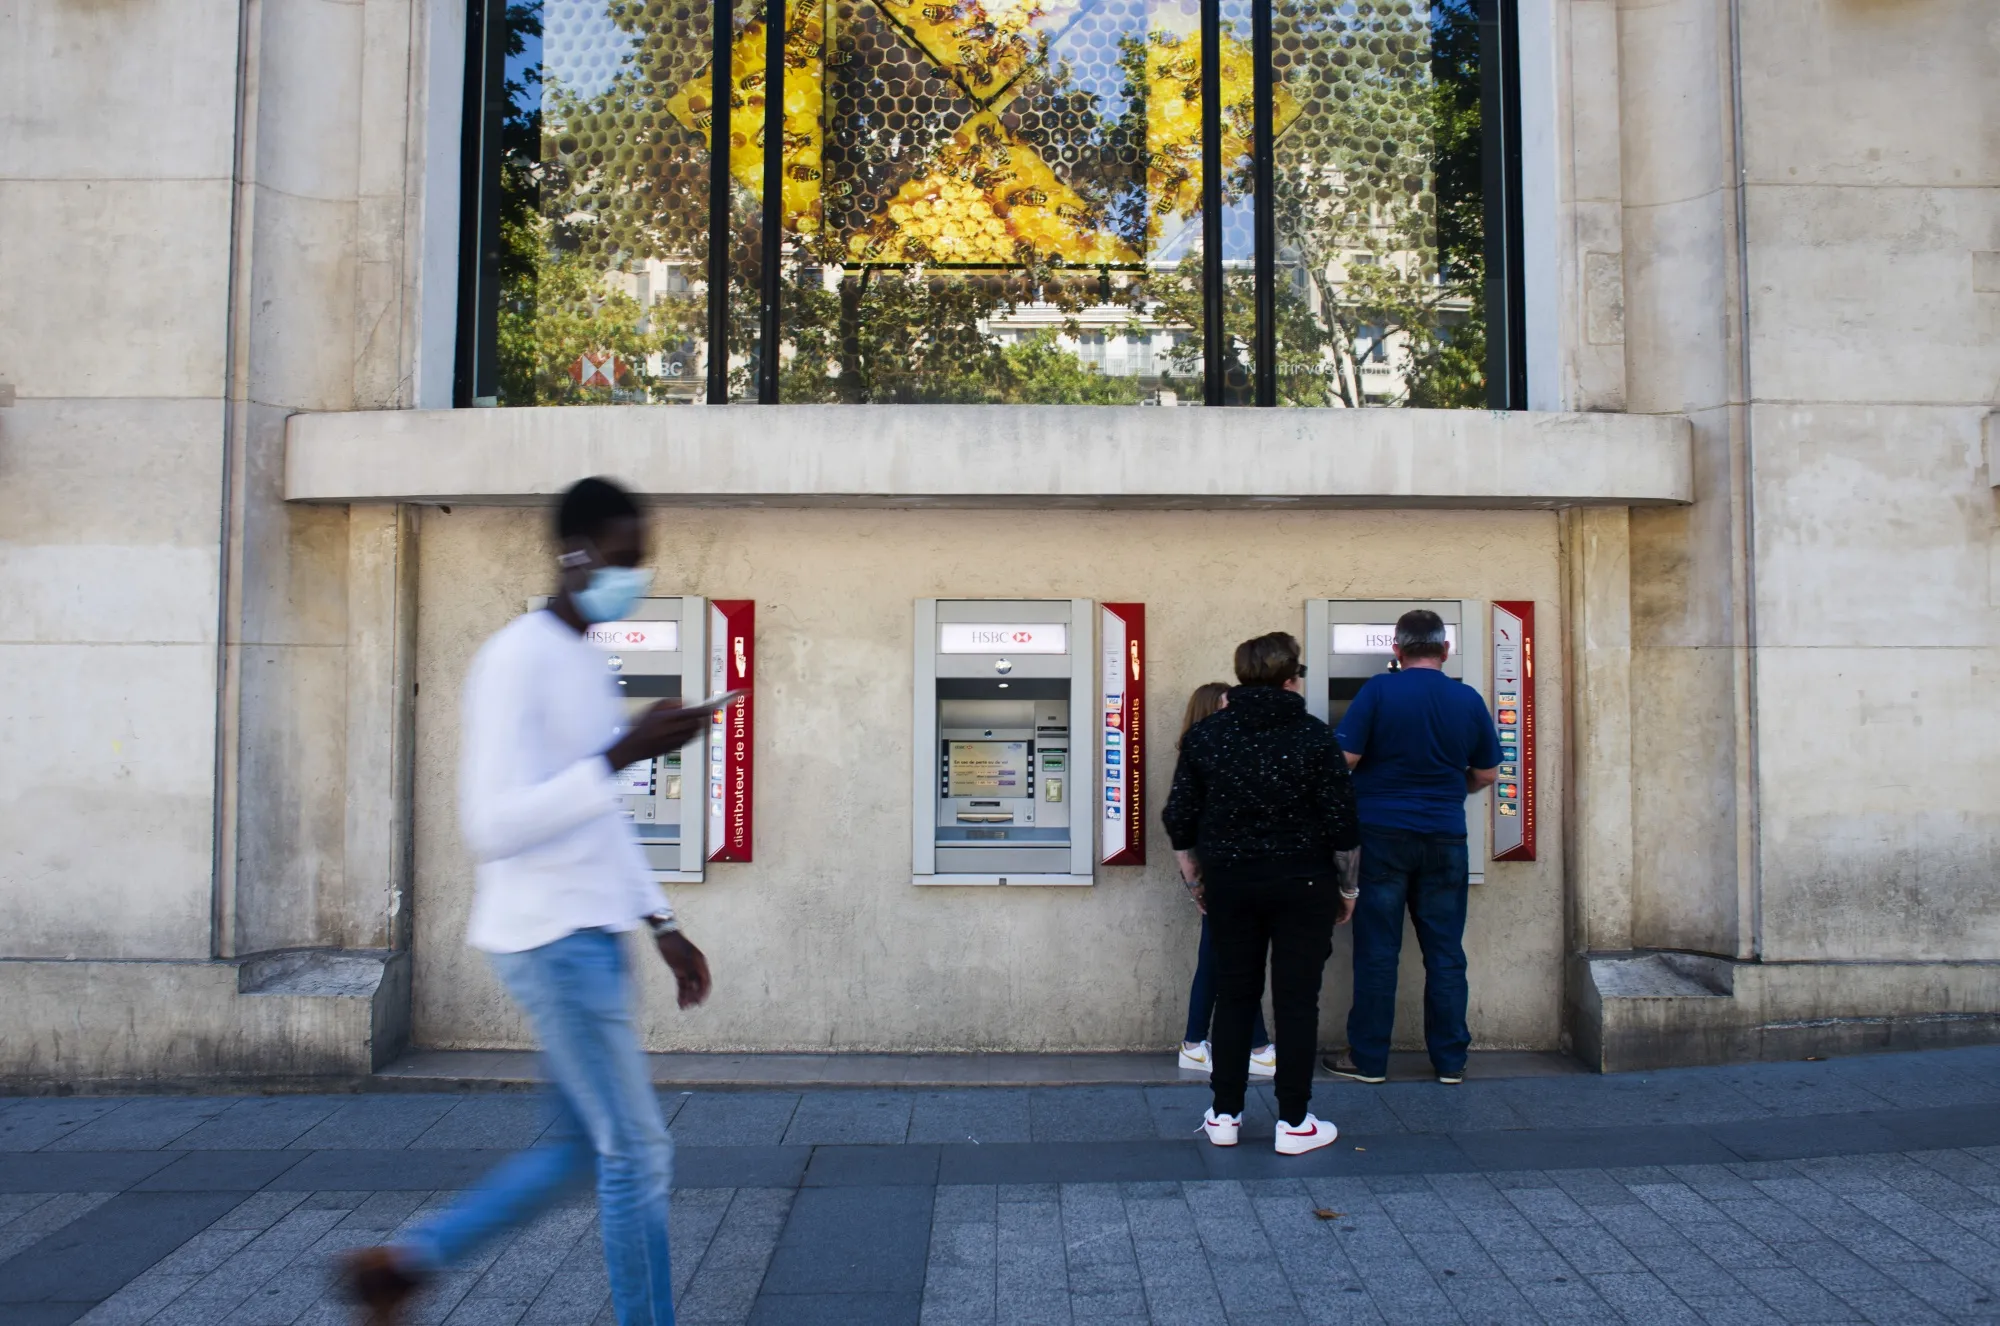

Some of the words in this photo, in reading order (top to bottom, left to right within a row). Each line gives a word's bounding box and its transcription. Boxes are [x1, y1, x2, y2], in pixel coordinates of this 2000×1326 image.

[634, 361, 683, 376] HBC
[586, 631, 623, 644] HSBC
[972, 631, 1010, 644] HSBC
[734, 695, 745, 738] billets
[1131, 698, 1140, 741] billets
[733, 741, 744, 761] de
[1132, 744, 1140, 764] de
[733, 766, 744, 848] distributeur
